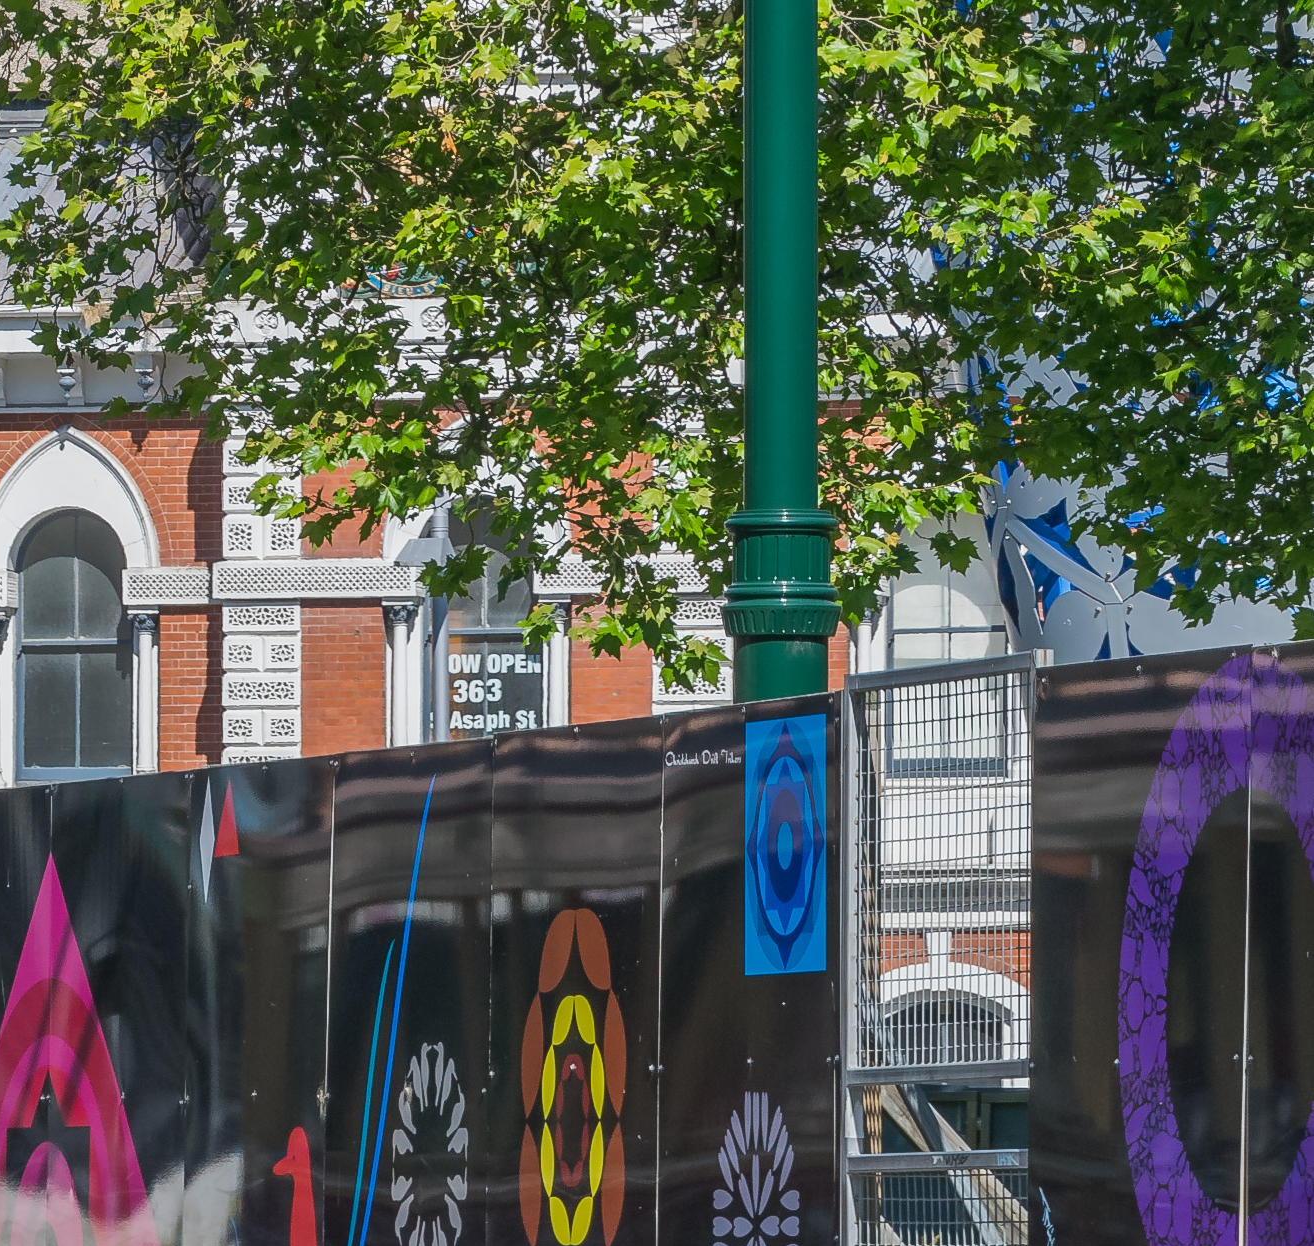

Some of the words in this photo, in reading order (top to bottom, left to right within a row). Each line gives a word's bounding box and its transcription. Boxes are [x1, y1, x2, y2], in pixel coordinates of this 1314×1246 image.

[448, 654, 482, 674] OW
[487, 654, 541, 674] OPEN
[452, 678, 502, 703] 363
[449, 710, 511, 732] Asaph
[515, 709, 537, 730] St
